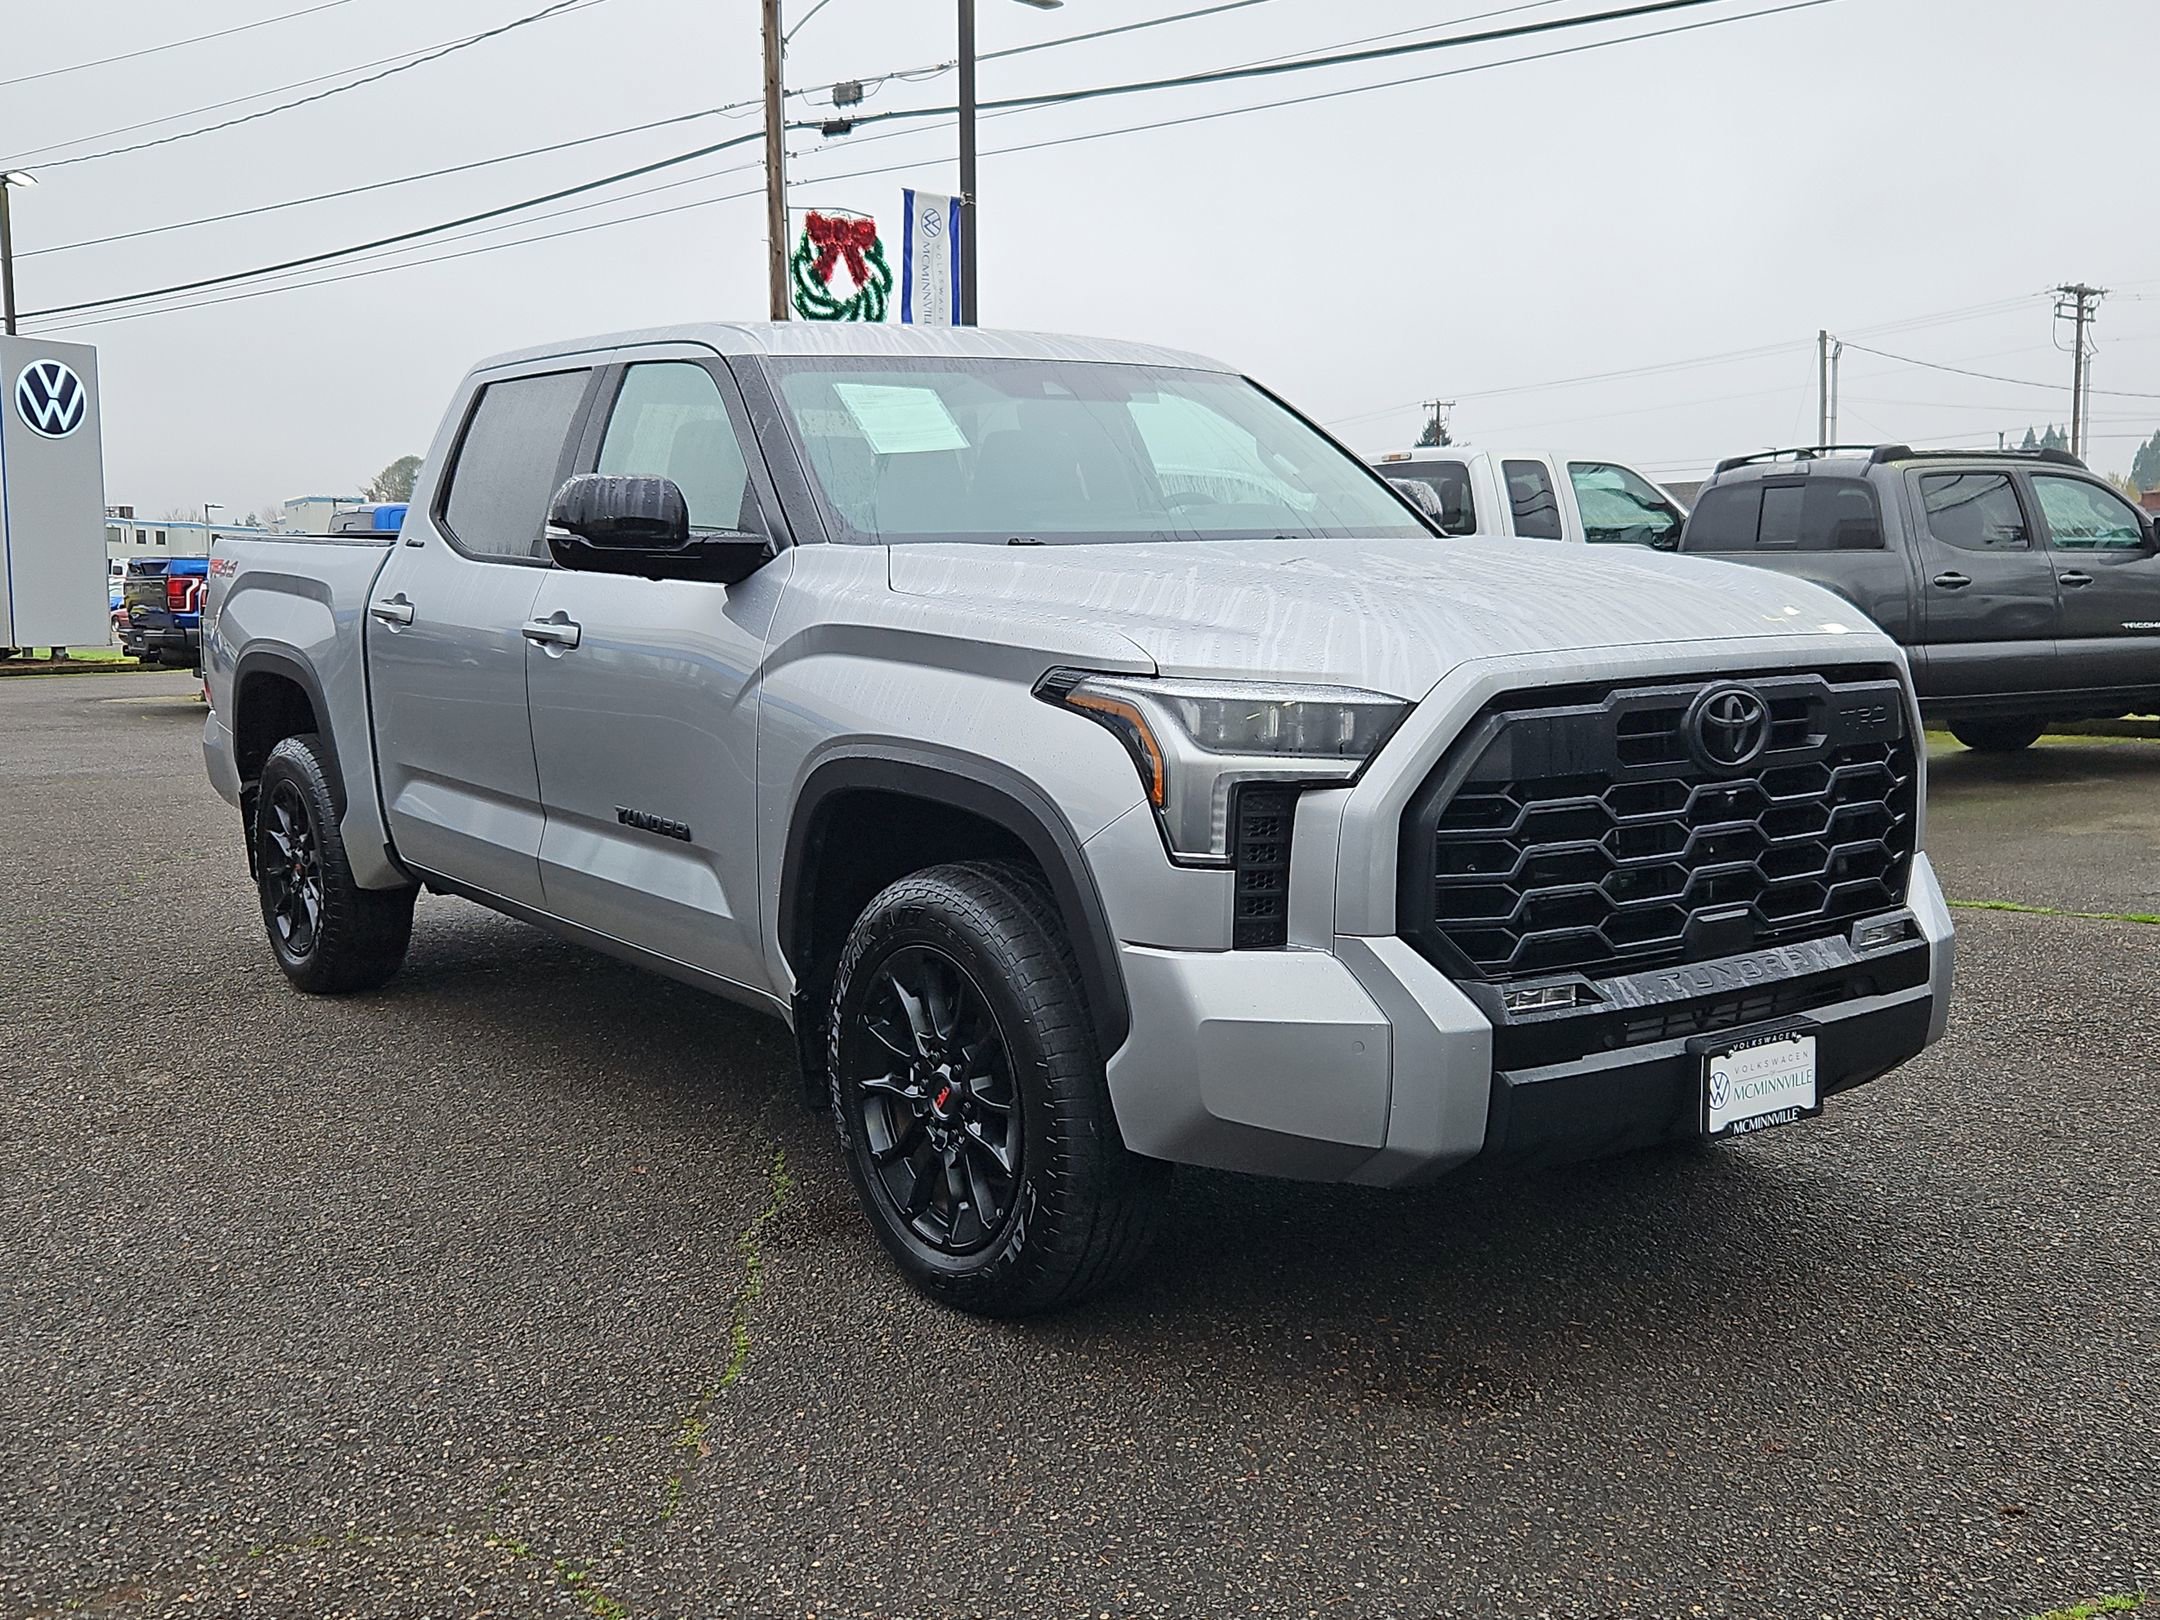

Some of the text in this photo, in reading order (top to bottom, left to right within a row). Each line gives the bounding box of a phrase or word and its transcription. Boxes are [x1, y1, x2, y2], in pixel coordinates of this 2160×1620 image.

[921, 241, 932, 325] MCMINNVILL
[935, 244, 945, 321] VOLKSWAGE
[16, 360, 86, 438] VW
[614, 805, 692, 843] TUNDRA
[1655, 947, 1812, 993] TUNDRA
[1733, 1031, 1798, 1051] VOLKSWAGEN
[1734, 1050, 1809, 1075] VOLKSWAGEN
[1733, 1068, 1813, 1101] MCMINNVILLE
[1733, 1107, 1799, 1135] MCMINNVILLE
